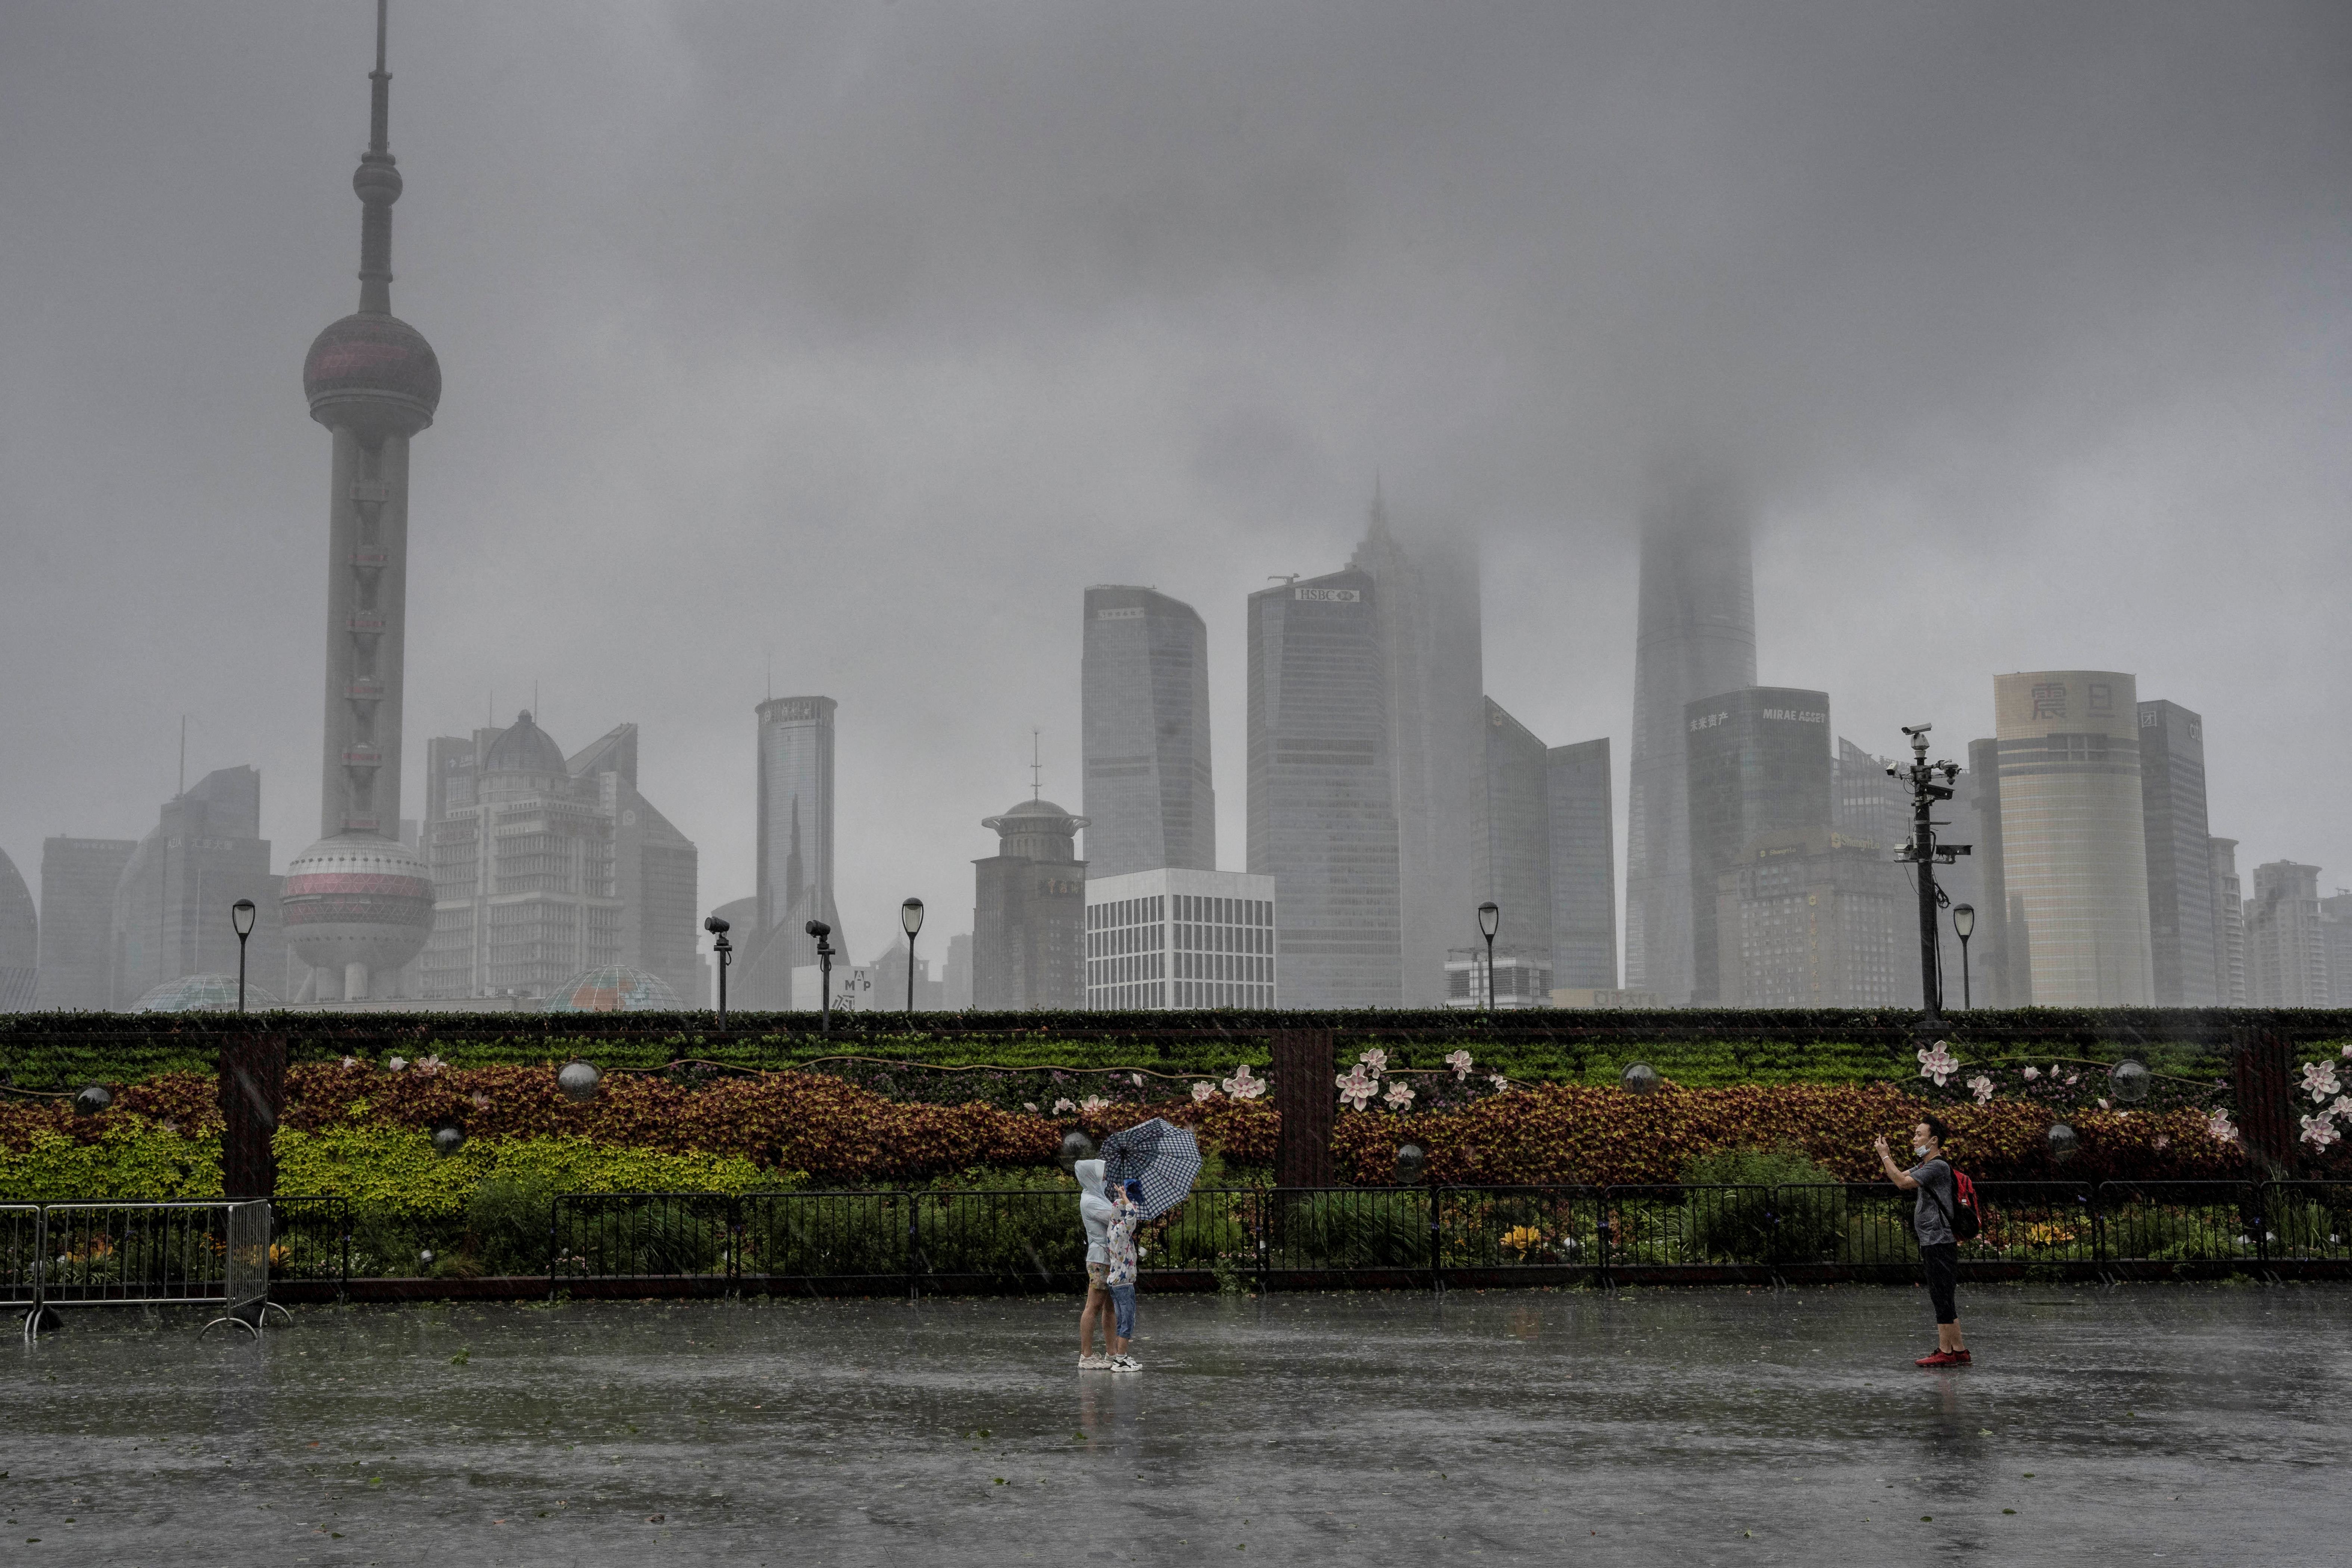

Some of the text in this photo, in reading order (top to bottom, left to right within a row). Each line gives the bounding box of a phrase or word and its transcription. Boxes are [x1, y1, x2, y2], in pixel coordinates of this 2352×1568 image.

[1300, 589, 1335, 600] HSBC
[2031, 682, 2116, 720] 震旦
[1689, 712, 1728, 733] 未来资产
[1763, 708, 1825, 723] MIRAE ASSET
[2141, 710, 2157, 728] 团
[845, 971, 871, 991] MAP
